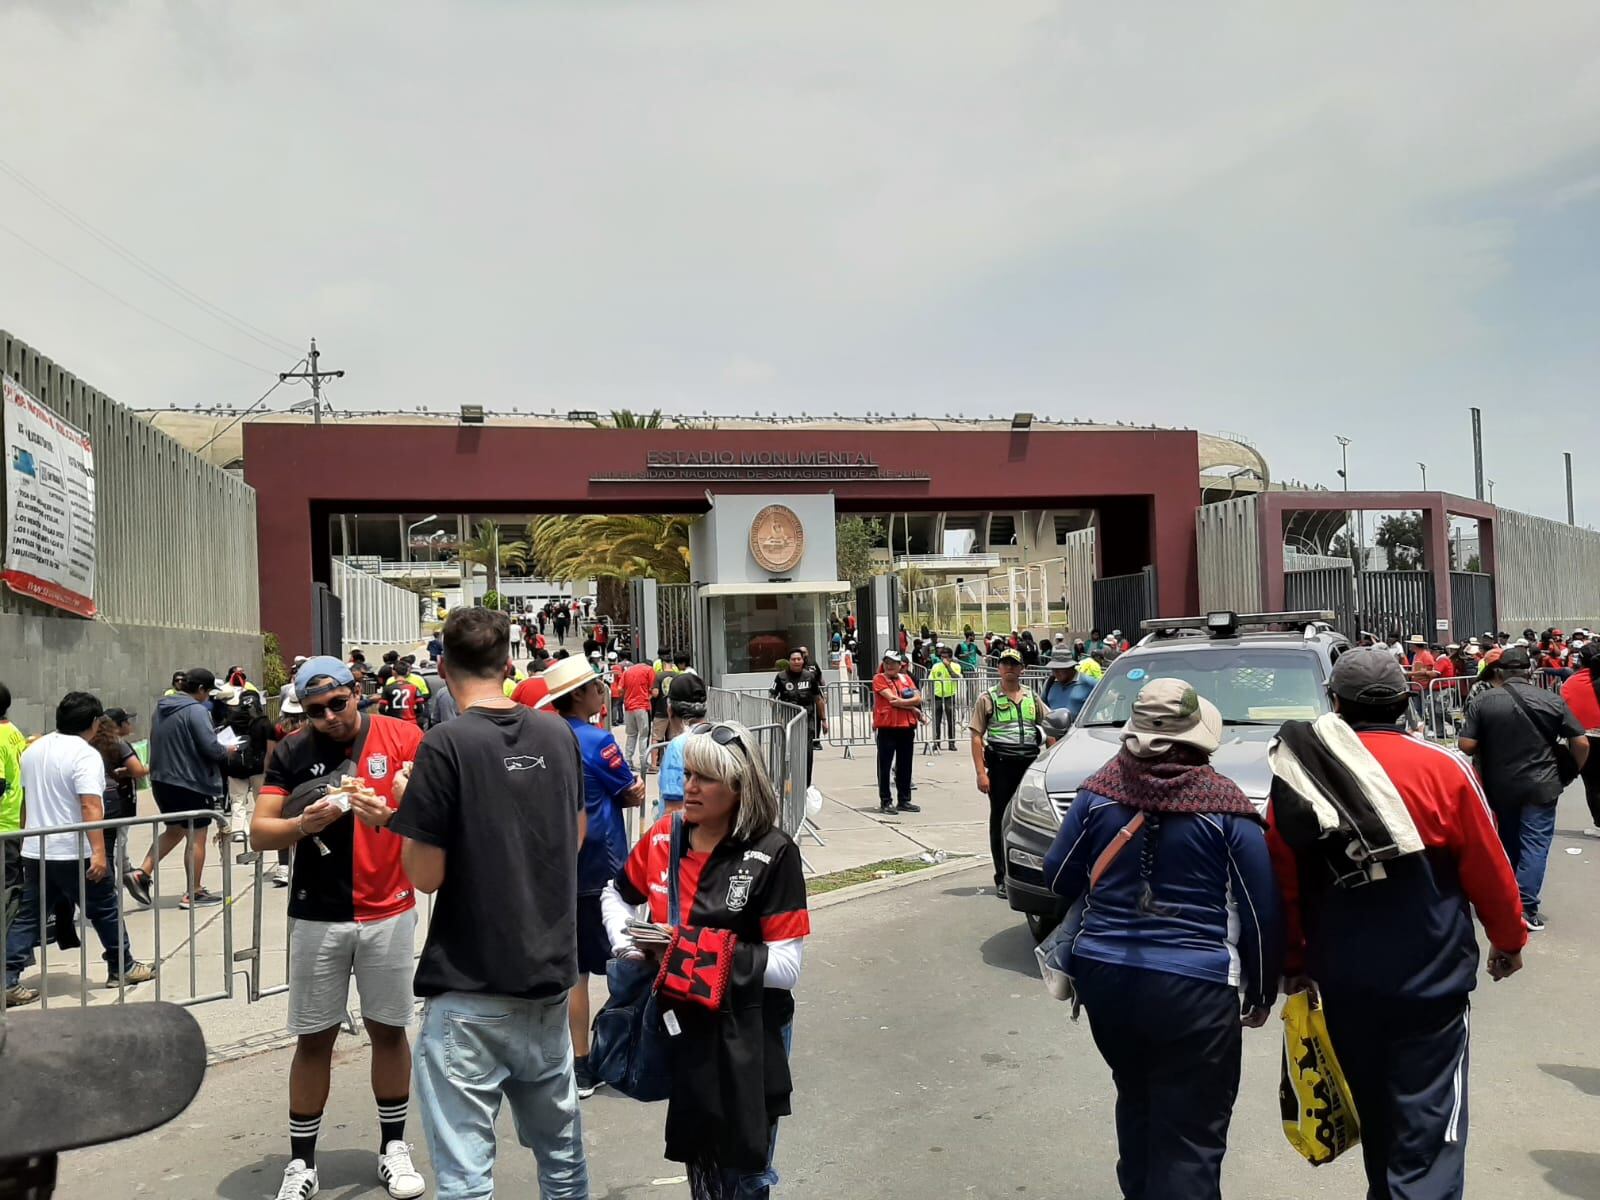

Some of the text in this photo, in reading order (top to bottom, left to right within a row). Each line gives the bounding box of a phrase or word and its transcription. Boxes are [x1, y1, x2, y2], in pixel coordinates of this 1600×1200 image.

[647, 450, 879, 464] ESTADIO MONUMENTAL
[679, 470, 743, 479] NACIONAL
[746, 470, 764, 479] DE
[767, 469, 792, 479] SAN
[850, 469, 865, 478] DE
[392, 688, 410, 709] 22
